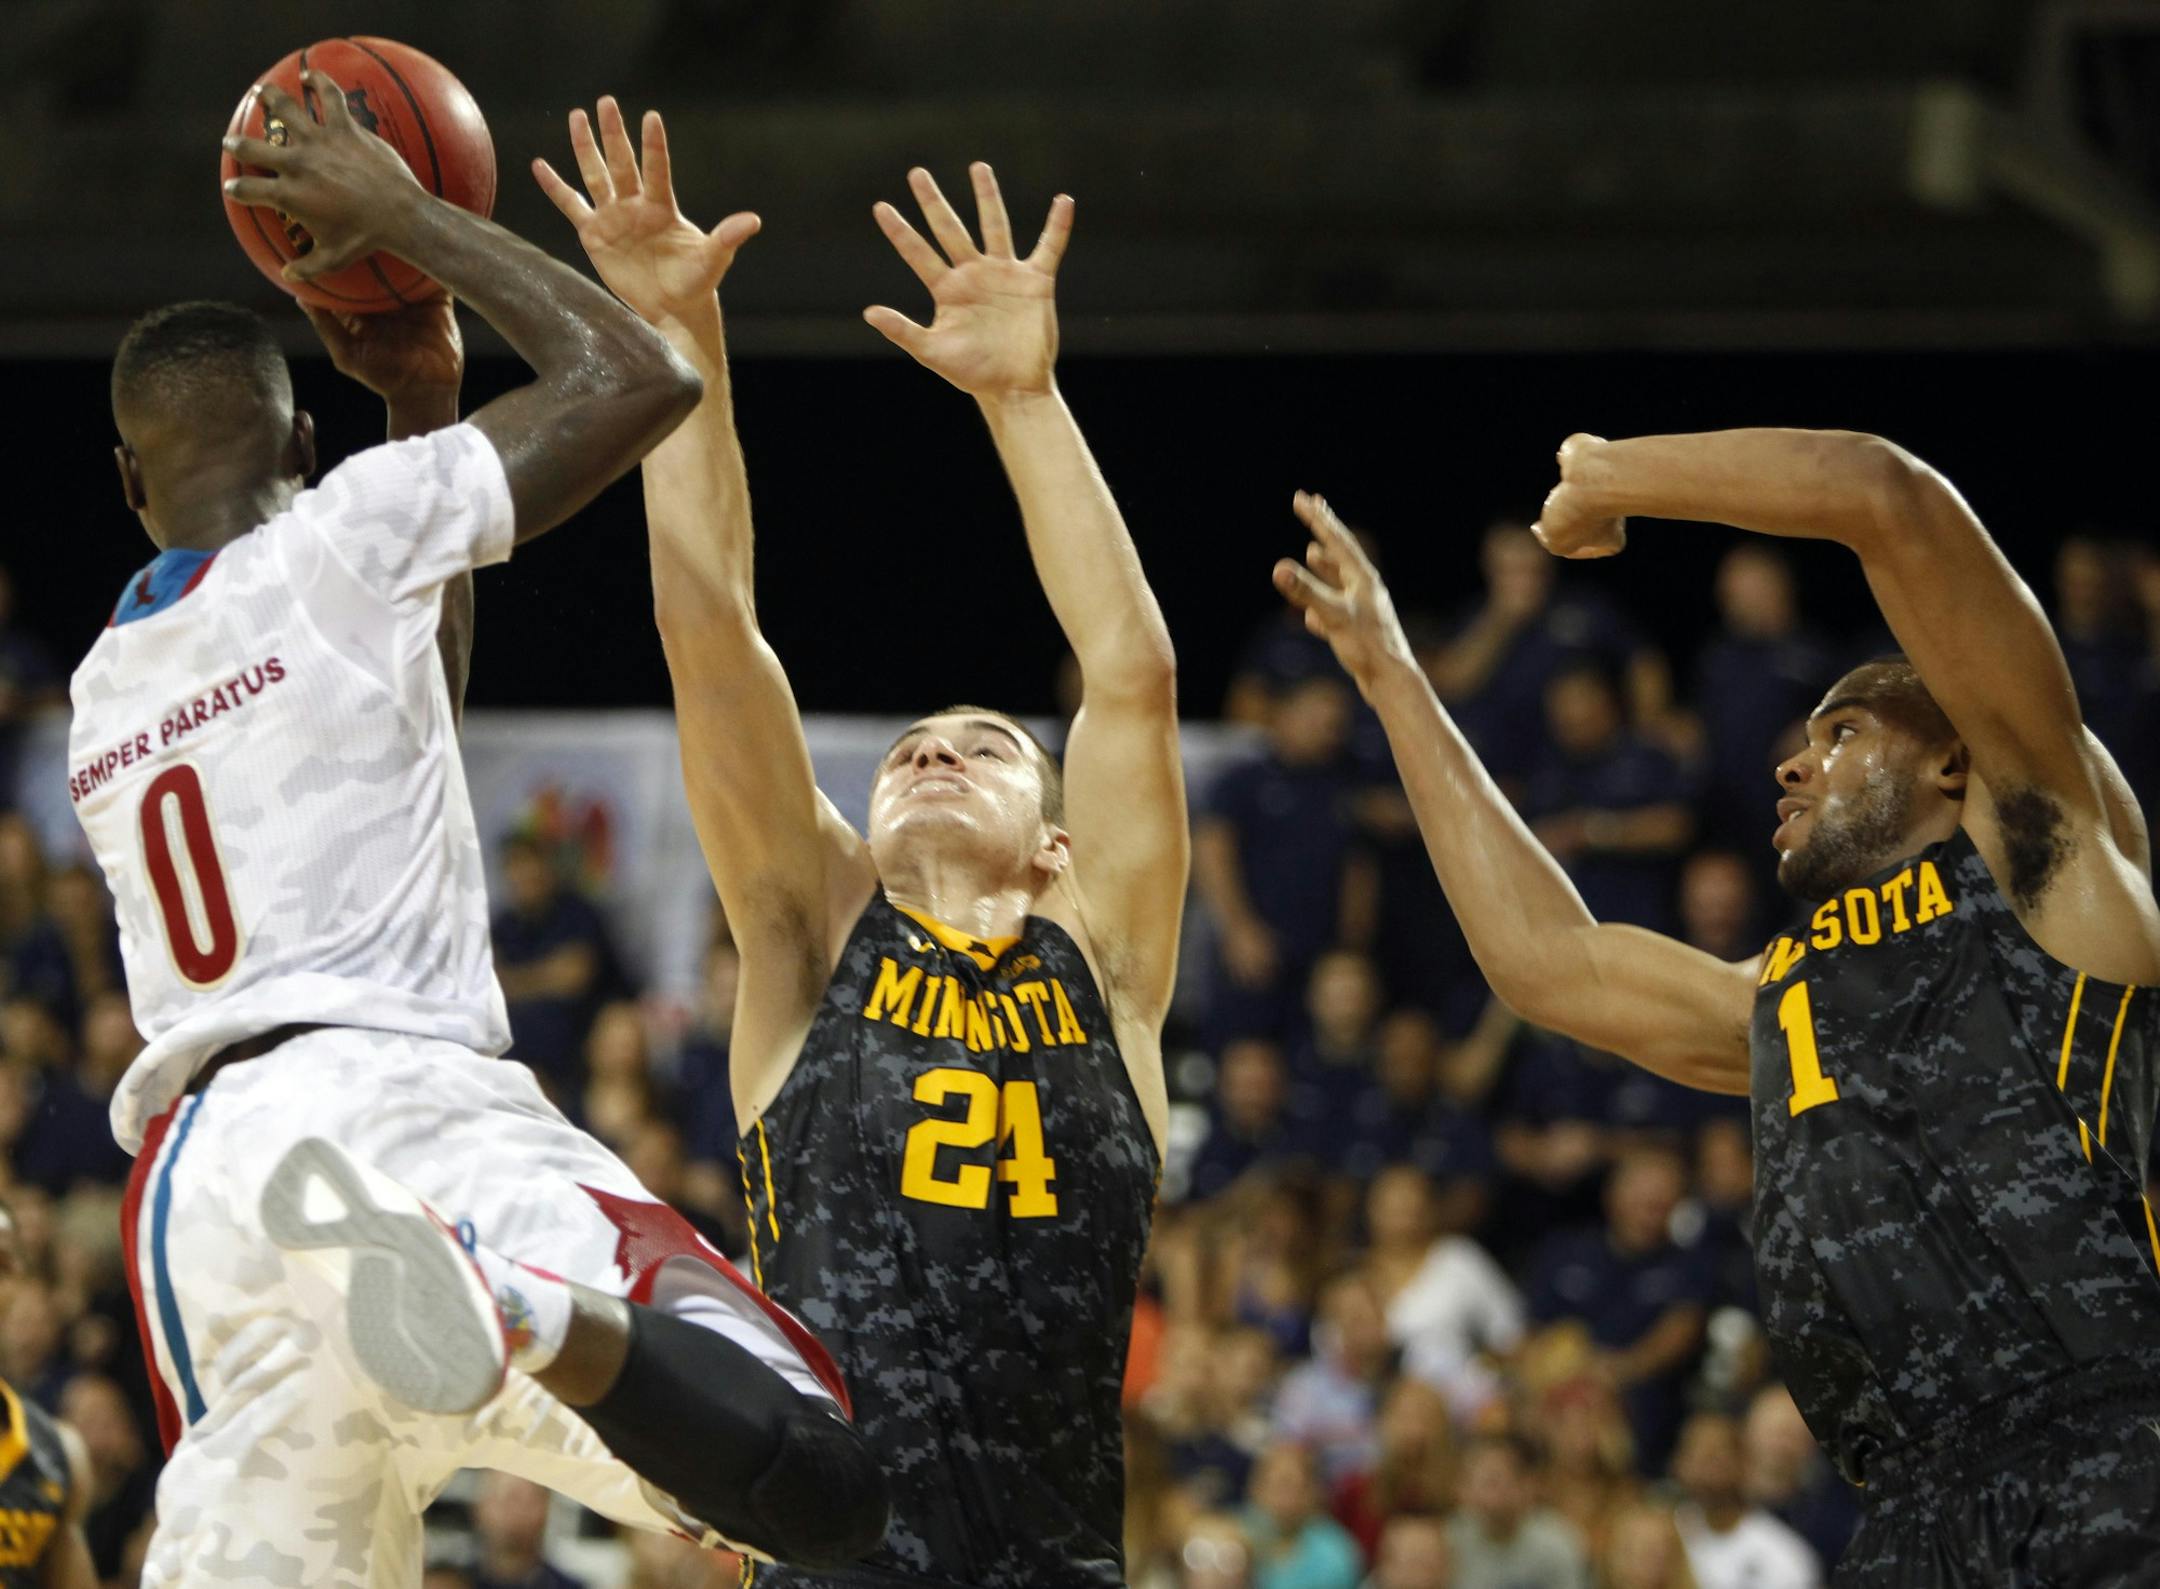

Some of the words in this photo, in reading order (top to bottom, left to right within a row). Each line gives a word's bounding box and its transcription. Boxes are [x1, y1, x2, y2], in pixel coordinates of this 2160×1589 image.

[68, 732, 153, 803] SEMPER
[160, 656, 286, 746] PARATUS
[140, 761, 241, 988] 0
[1776, 980, 1840, 1118] 1
[900, 1067, 1059, 1219] 24
